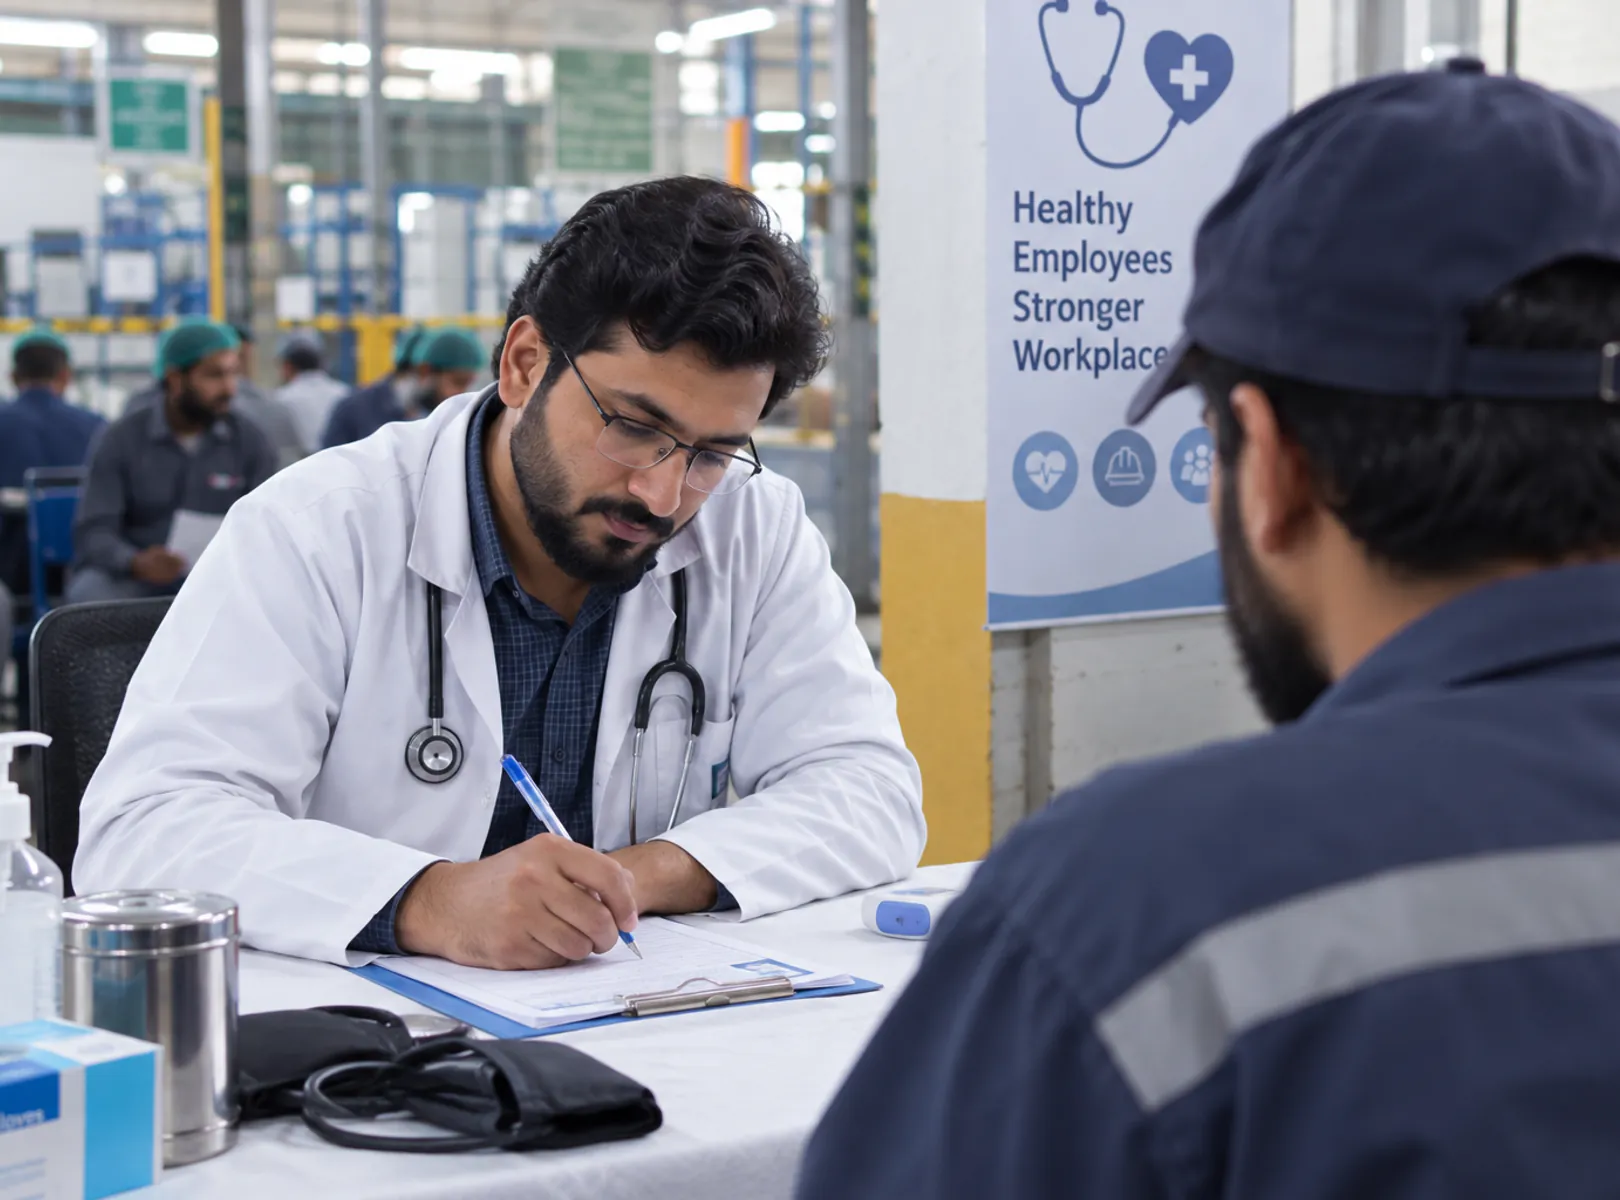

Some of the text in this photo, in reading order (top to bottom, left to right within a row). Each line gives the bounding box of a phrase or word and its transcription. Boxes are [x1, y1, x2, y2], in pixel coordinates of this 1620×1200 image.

[1013, 189, 1133, 234] Healthy
[1013, 240, 1173, 282] Employees
[1013, 290, 1144, 331] Stronger
[1013, 337, 1168, 379] Workplace
